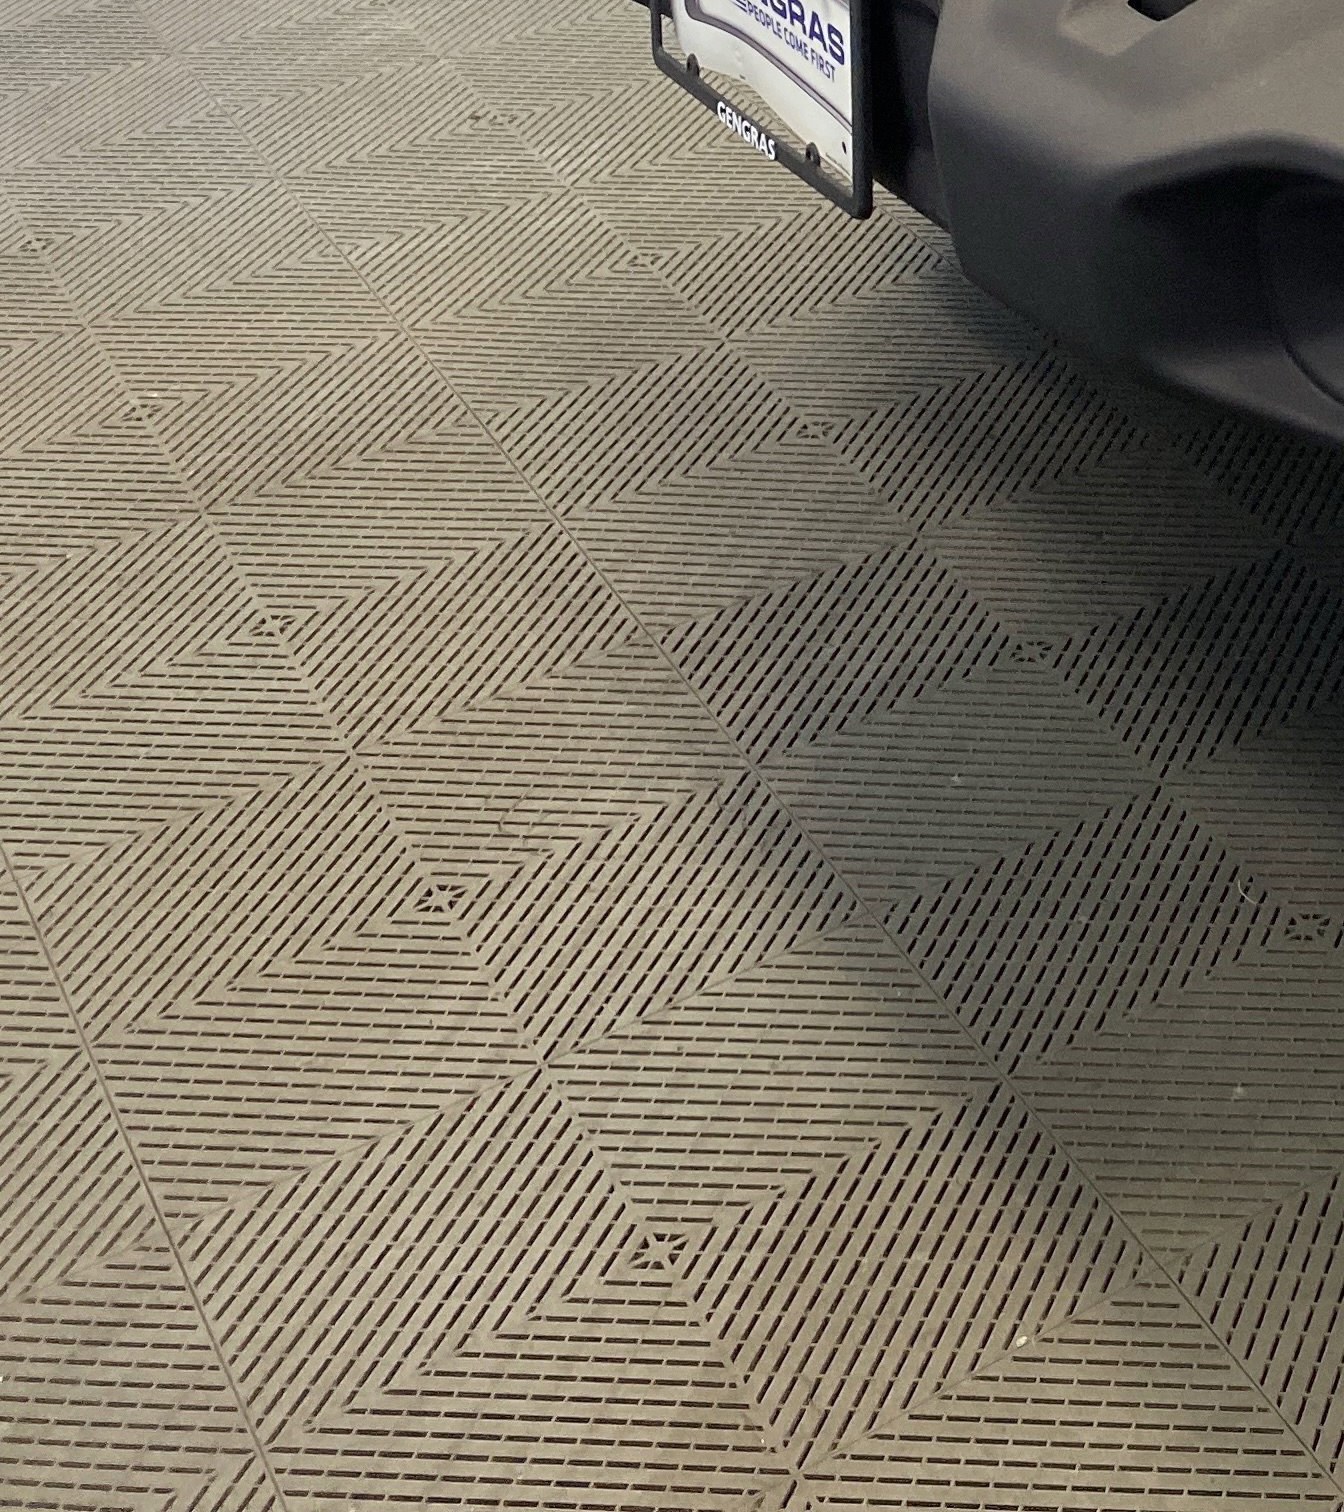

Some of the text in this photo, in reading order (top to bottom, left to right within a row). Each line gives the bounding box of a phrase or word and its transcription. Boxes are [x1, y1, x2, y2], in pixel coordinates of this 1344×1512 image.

[747, 0, 836, 83] PEOPLE COME FIRST
[716, 100, 776, 161] GENGRAS
